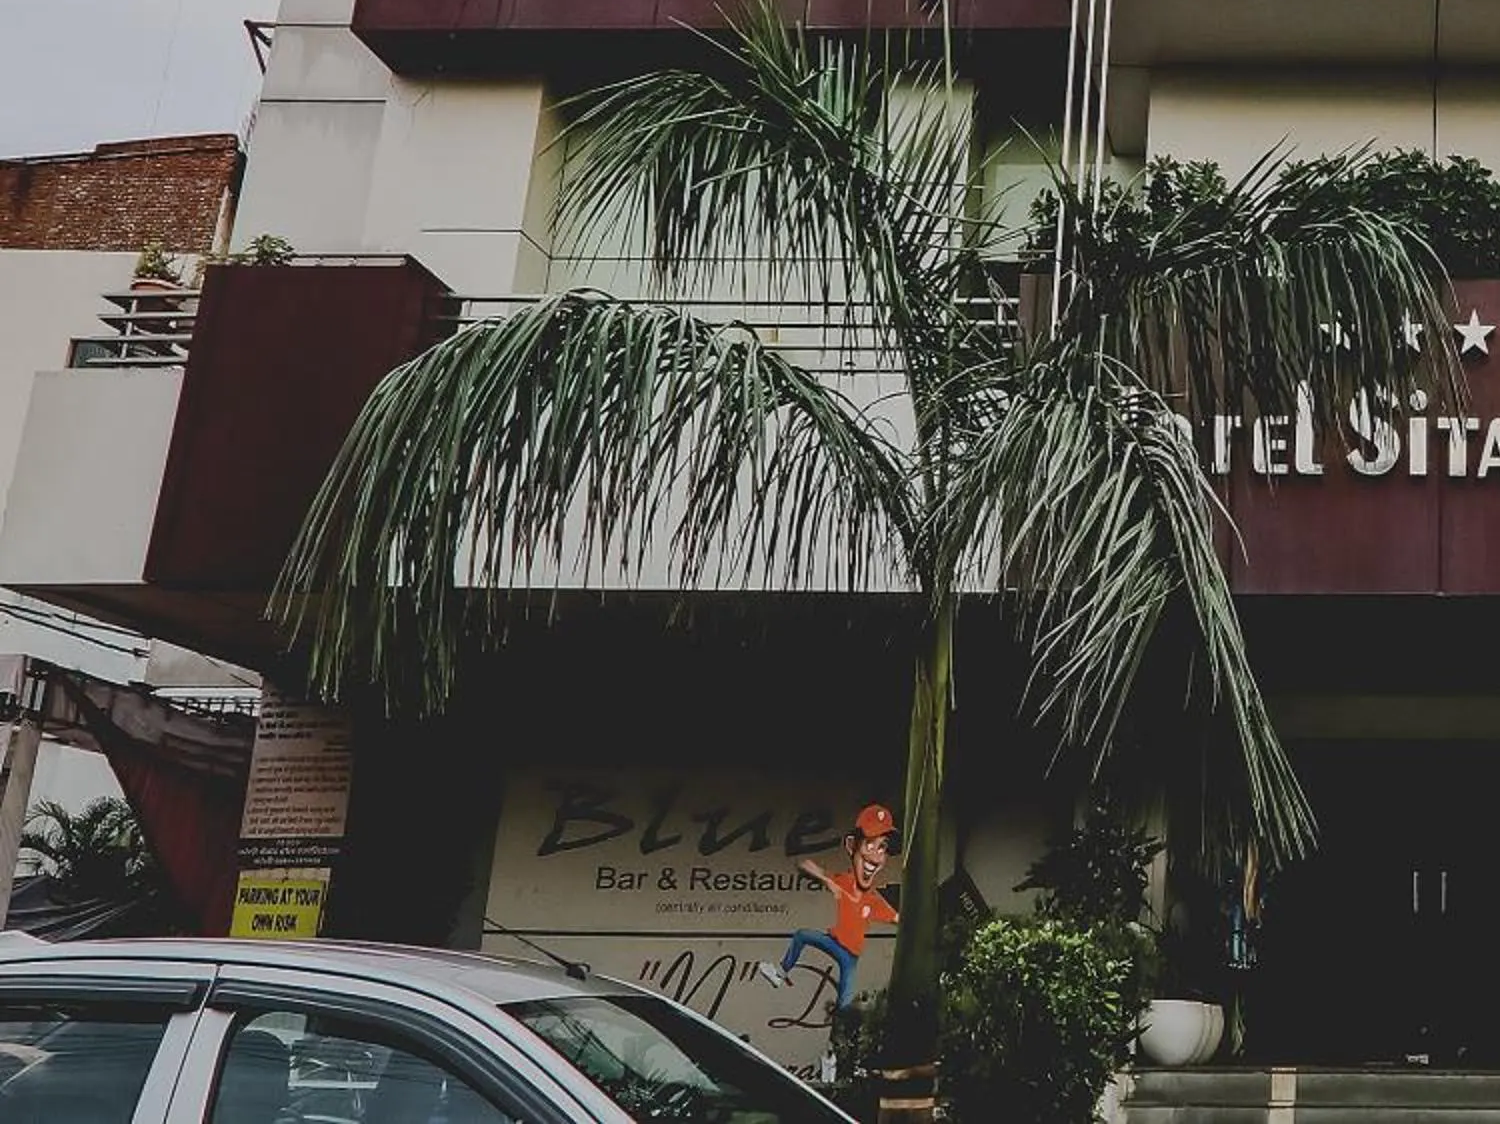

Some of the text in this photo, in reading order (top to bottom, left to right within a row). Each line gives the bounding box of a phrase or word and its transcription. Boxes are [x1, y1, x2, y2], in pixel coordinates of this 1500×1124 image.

[536, 780, 842, 856] Blue
[596, 867, 648, 890] Bar
[658, 867, 677, 890] &
[238, 886, 321, 907] PARKING AT YOUR
[251, 913, 298, 932] OWN RISK
